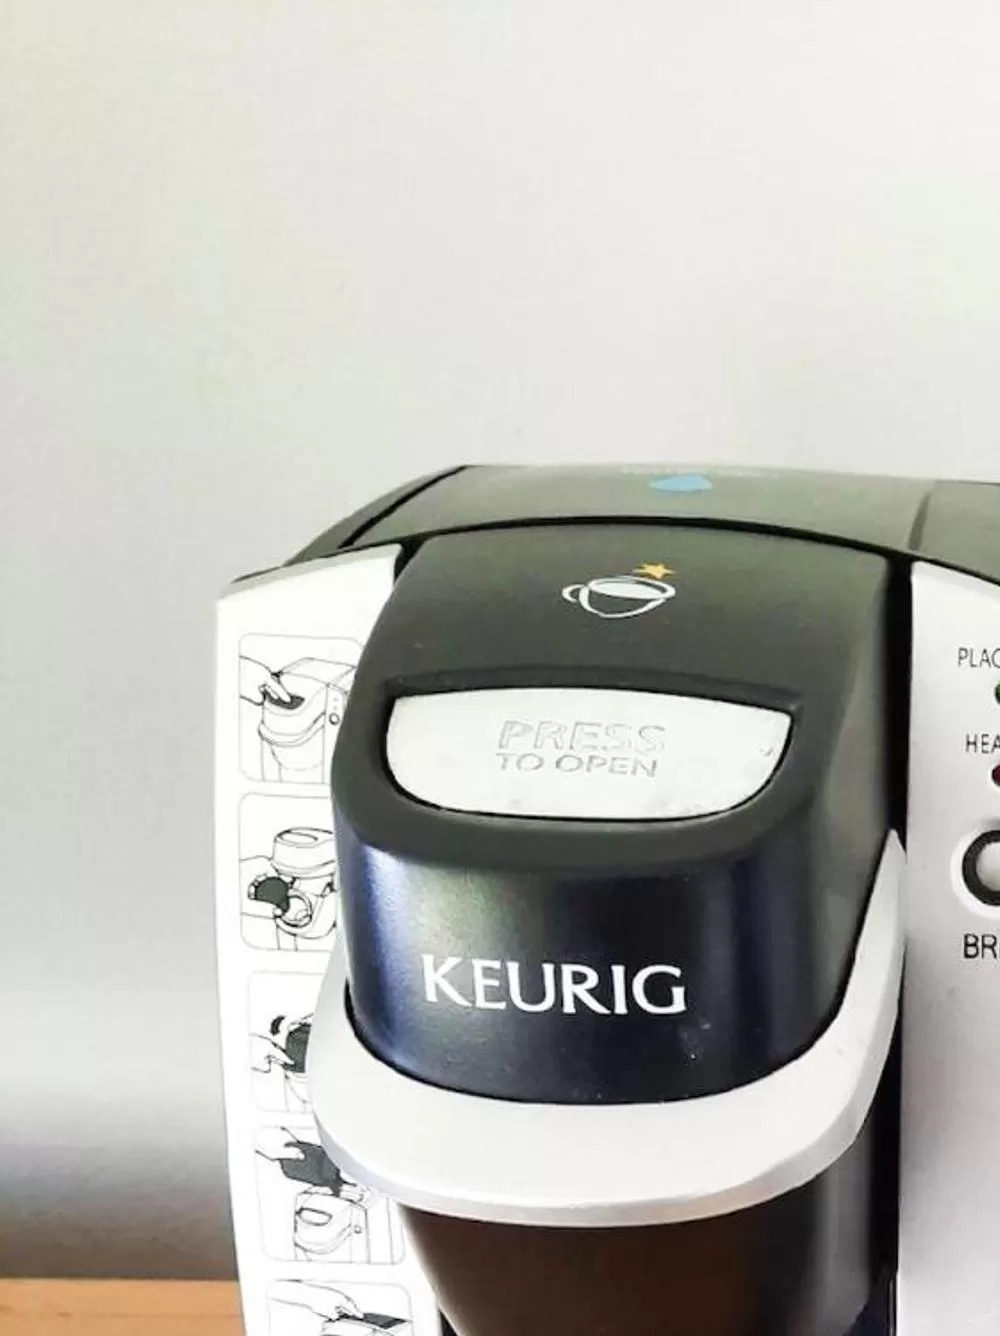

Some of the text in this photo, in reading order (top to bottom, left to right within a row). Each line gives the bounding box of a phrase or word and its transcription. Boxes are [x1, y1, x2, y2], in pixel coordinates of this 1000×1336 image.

[497, 719, 667, 752] PRESS
[495, 751, 658, 778] TO OPEN
[420, 952, 687, 1016] KEURIG
